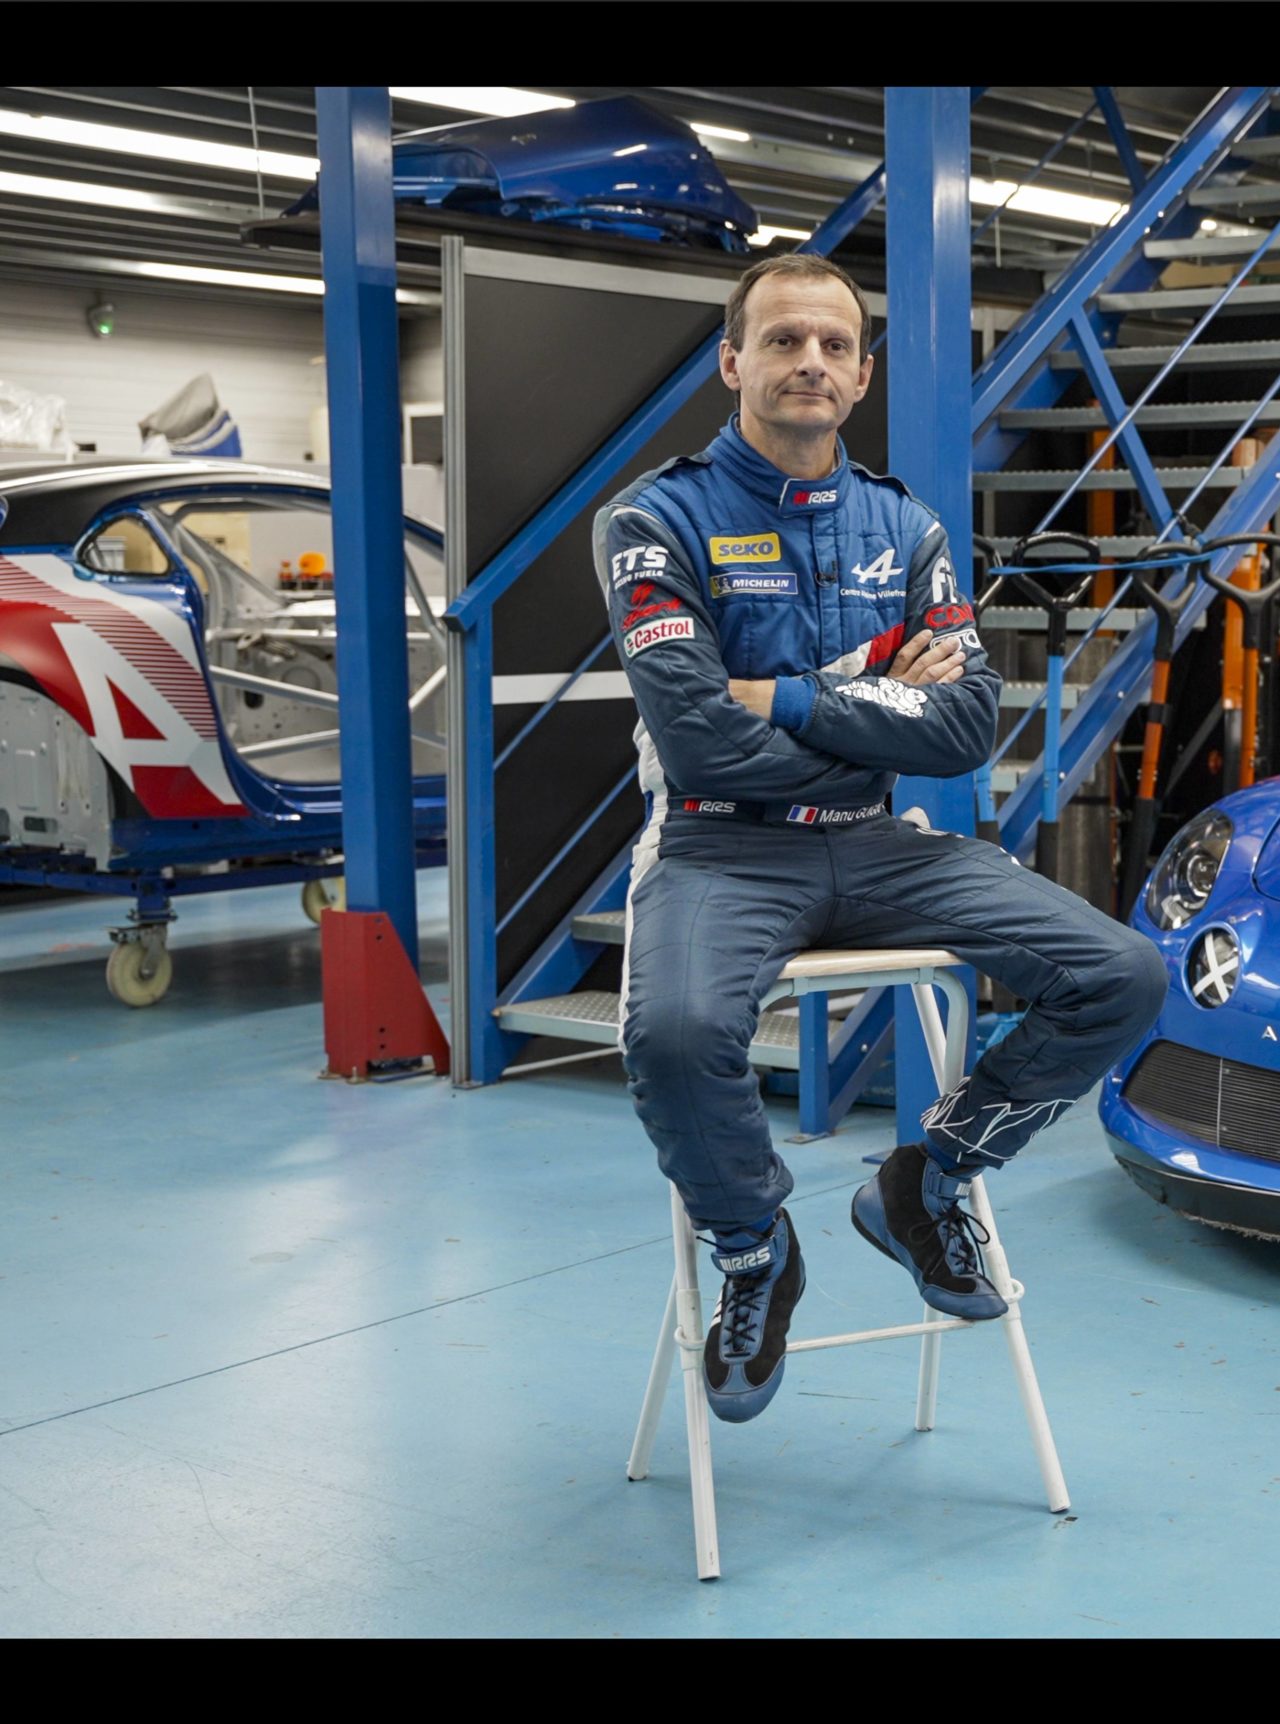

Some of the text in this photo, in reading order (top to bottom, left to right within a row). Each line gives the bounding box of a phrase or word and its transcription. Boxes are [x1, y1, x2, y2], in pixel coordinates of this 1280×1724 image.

[612, 546, 669, 580] ETS
[732, 579, 790, 588] MICHELIN
[634, 620, 692, 649] Castrol
[698, 801, 737, 813] RRS
[819, 809, 857, 823] Manu
[731, 1246, 771, 1271] RRS
